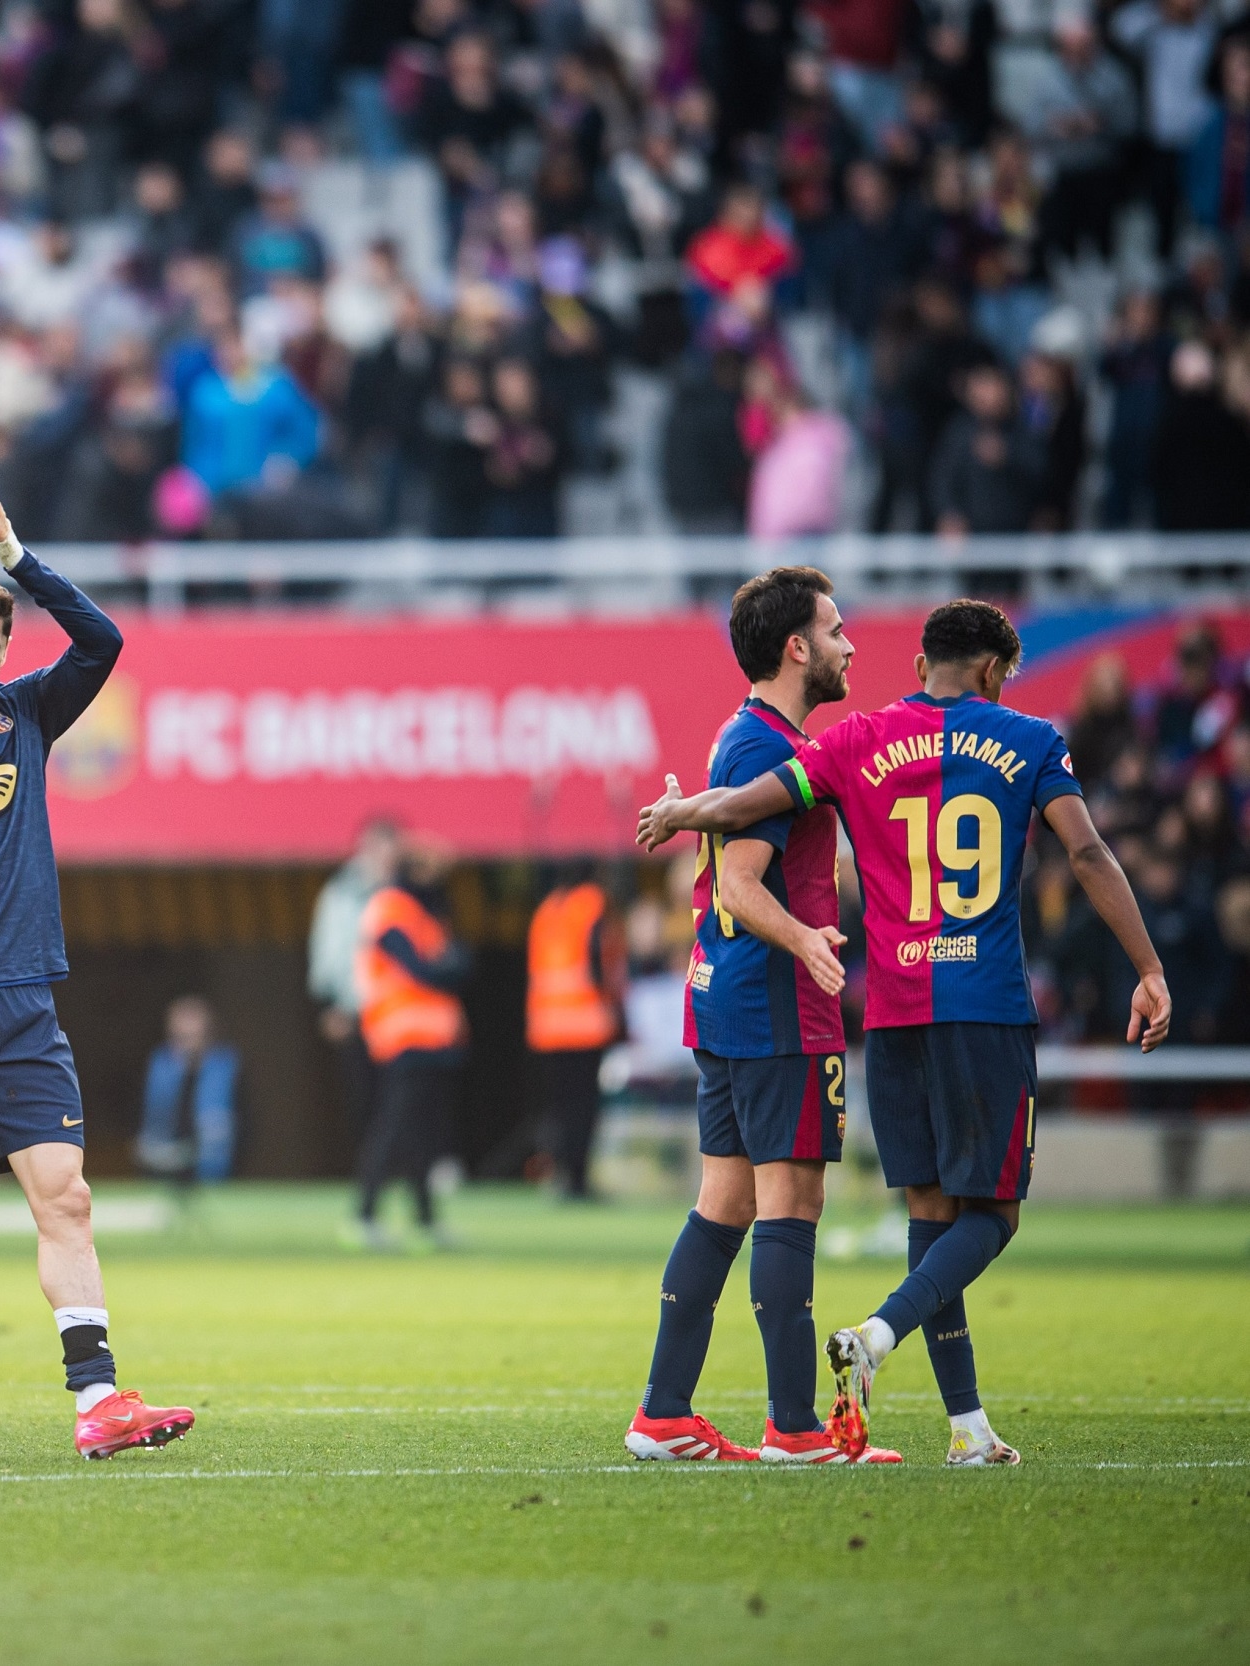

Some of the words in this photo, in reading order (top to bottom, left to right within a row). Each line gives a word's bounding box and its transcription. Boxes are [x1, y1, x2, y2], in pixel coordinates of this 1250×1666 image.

[147, 687, 238, 781] FC
[242, 684, 658, 780] BARCELONA
[860, 732, 944, 788] LAMINE
[951, 731, 1027, 784] YAMAL
[888, 793, 1002, 922] 19
[926, 946, 977, 958] ACNUR
[928, 935, 977, 948] UNHCR
